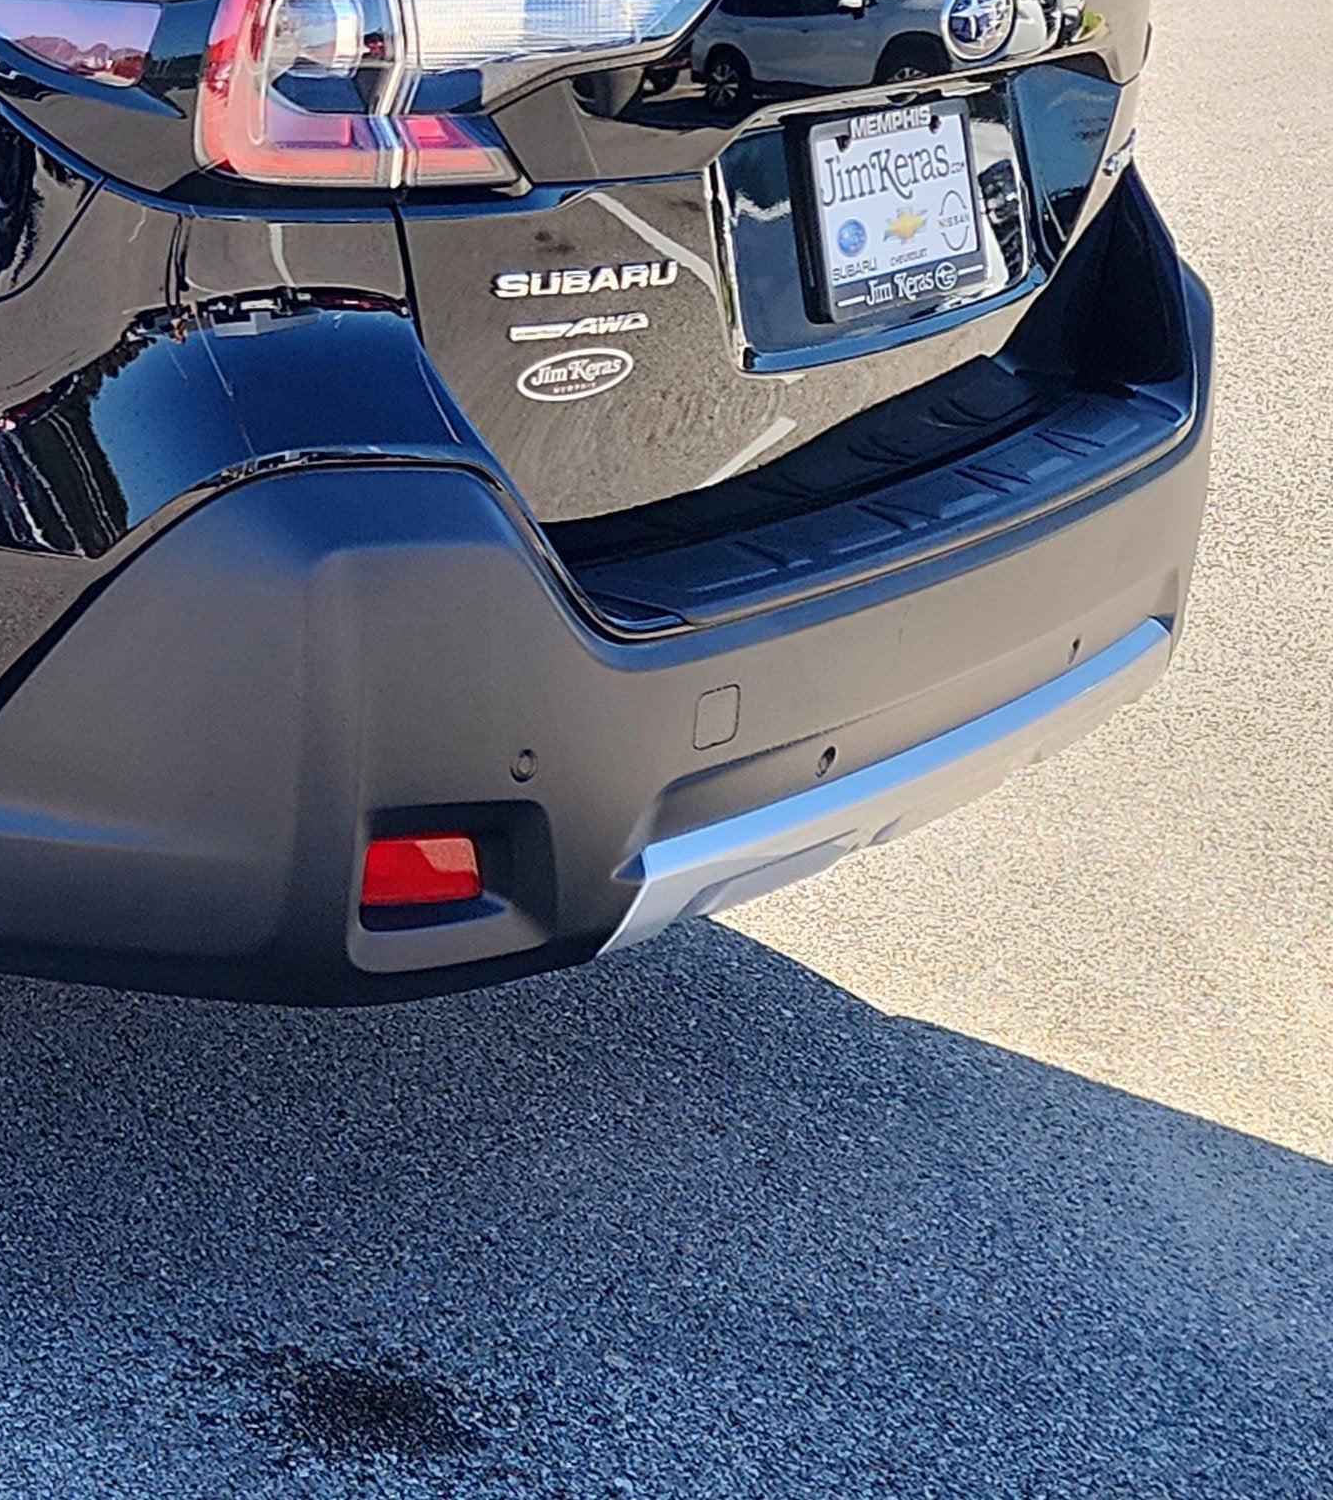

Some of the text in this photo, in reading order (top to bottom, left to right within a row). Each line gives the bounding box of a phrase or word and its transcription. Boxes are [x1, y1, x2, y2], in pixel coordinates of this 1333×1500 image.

[850, 106, 932, 139] MEMPHIS
[493, 261, 679, 298] SUBARU
[832, 258, 878, 282] SUBARU
[864, 272, 935, 306] Jim Keras
[564, 312, 649, 338] AWD
[530, 359, 622, 386] Jim Keras
